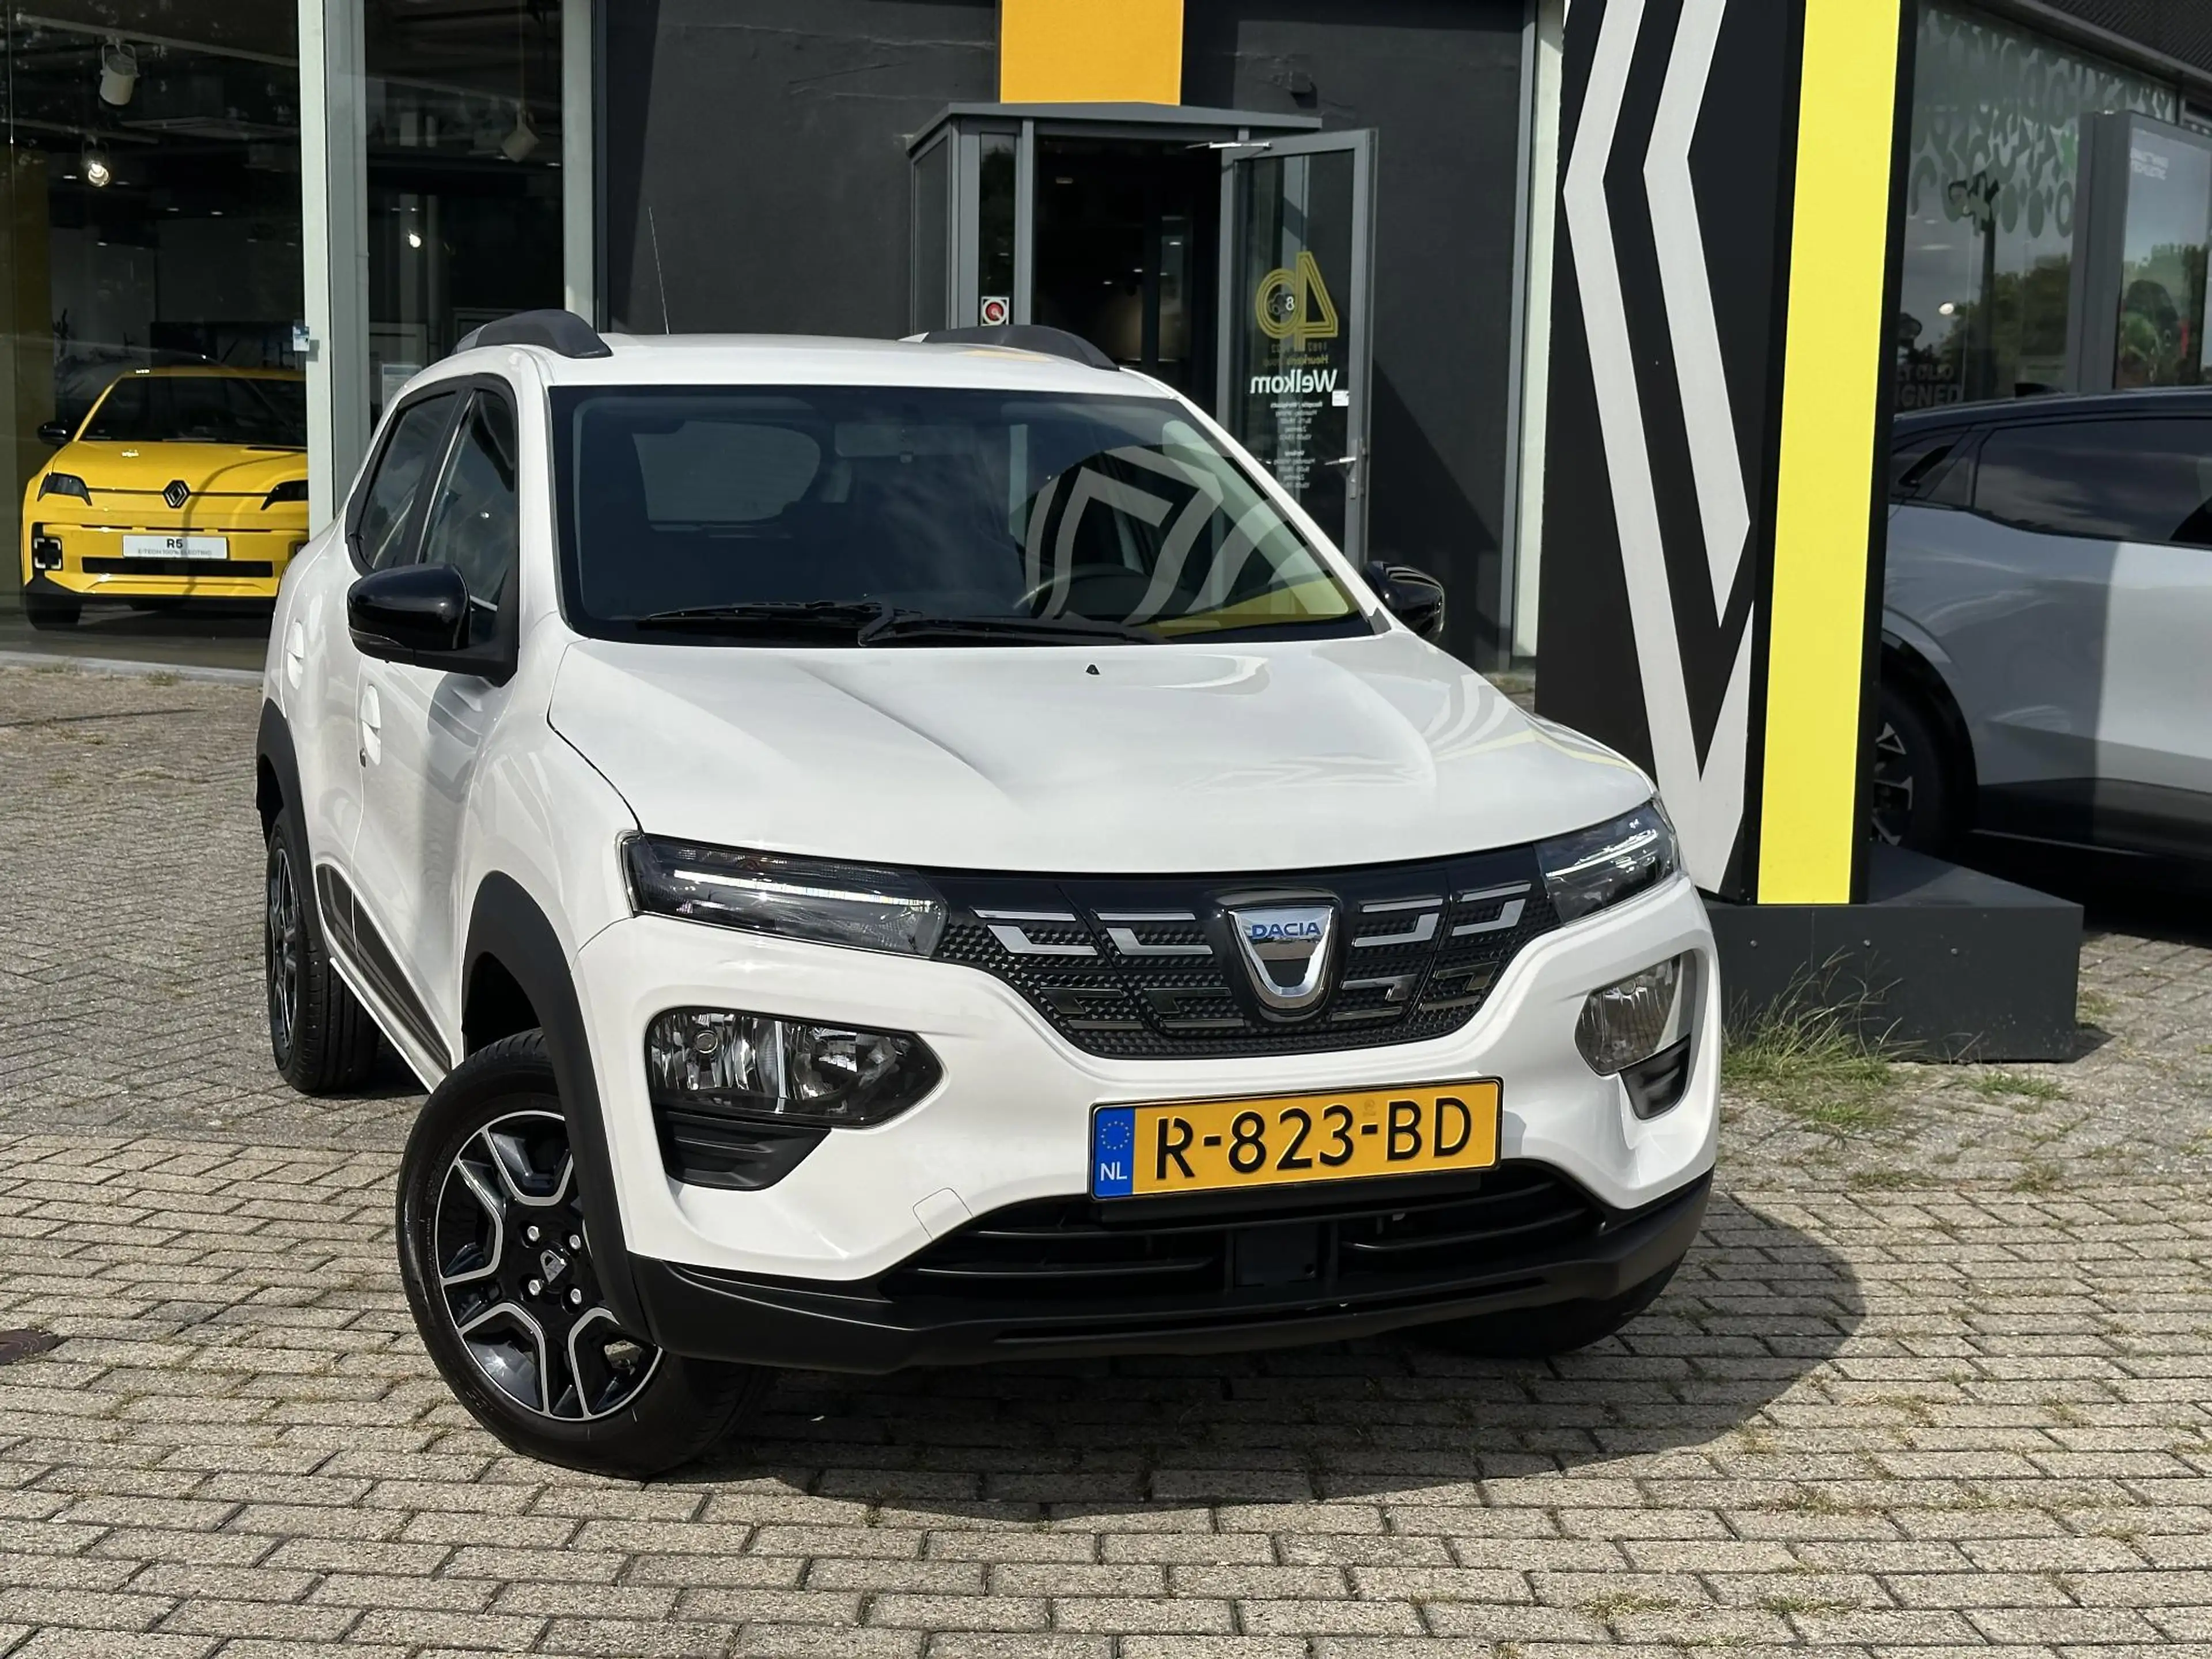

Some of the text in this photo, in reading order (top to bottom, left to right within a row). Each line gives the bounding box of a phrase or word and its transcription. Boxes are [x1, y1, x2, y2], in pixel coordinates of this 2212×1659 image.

[167, 539, 183, 548] R5
[1252, 922, 1320, 937] DACIA
[1100, 1096, 1472, 1182] NL R-823-BD
